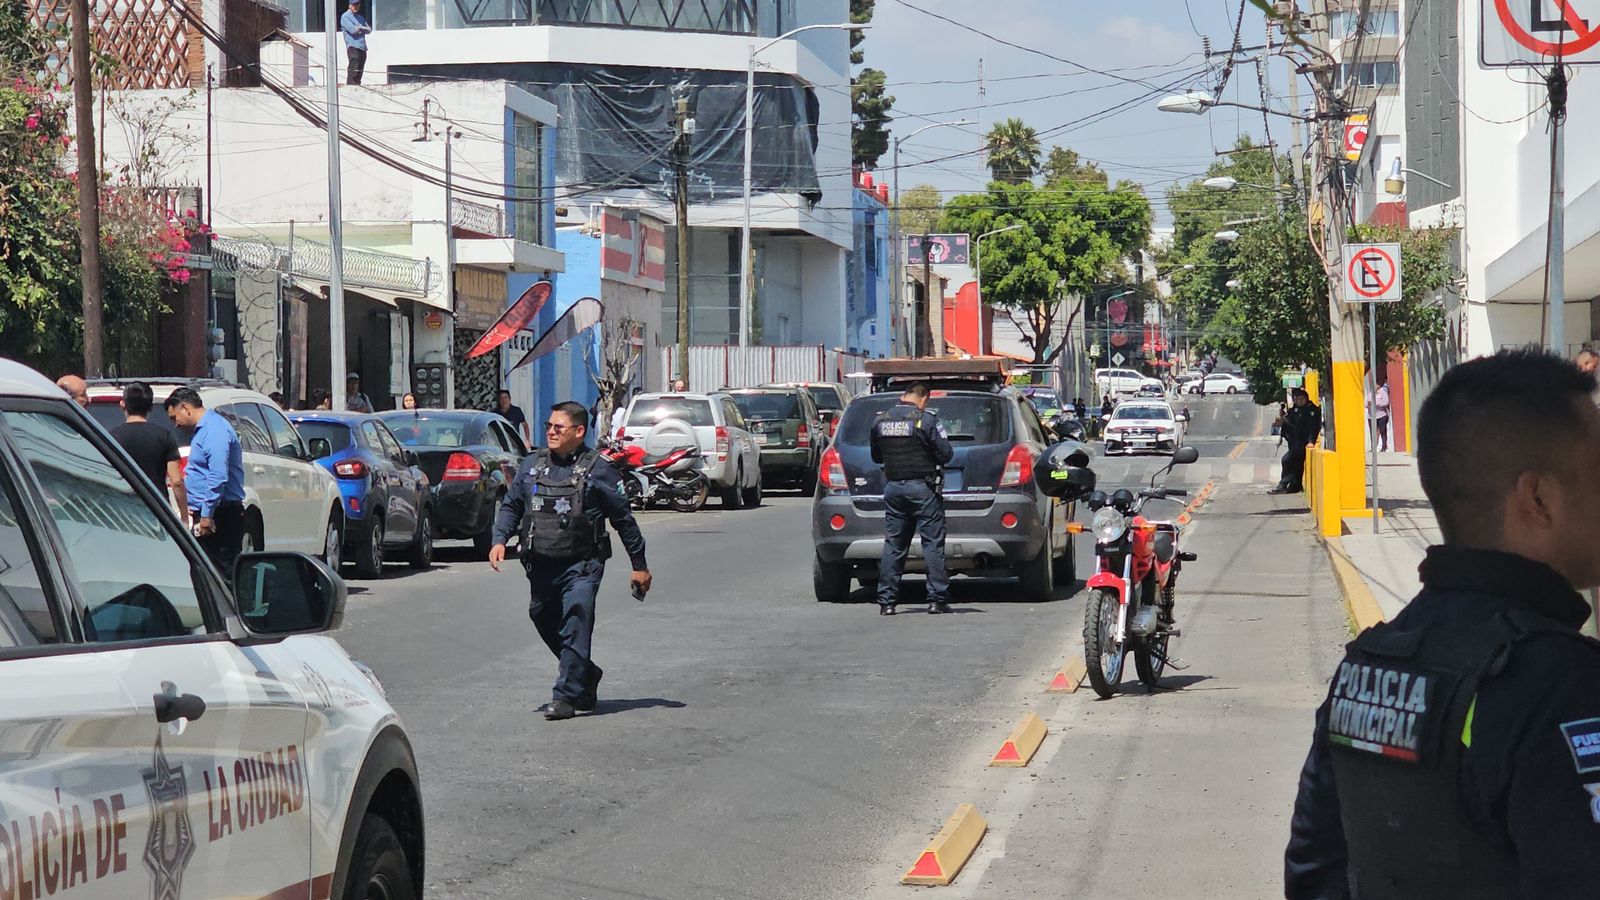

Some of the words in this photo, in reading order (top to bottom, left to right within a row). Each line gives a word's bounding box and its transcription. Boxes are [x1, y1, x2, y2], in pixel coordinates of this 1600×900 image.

[1362, 257, 1382, 288] E
[1333, 662, 1427, 713] POLICIA
[1329, 697, 1417, 750] MUNICIPAL
[1572, 732, 1600, 748] FUE
[93, 793, 128, 880] DE
[203, 766, 233, 843] LA
[234, 744, 305, 832] CIUDAD
